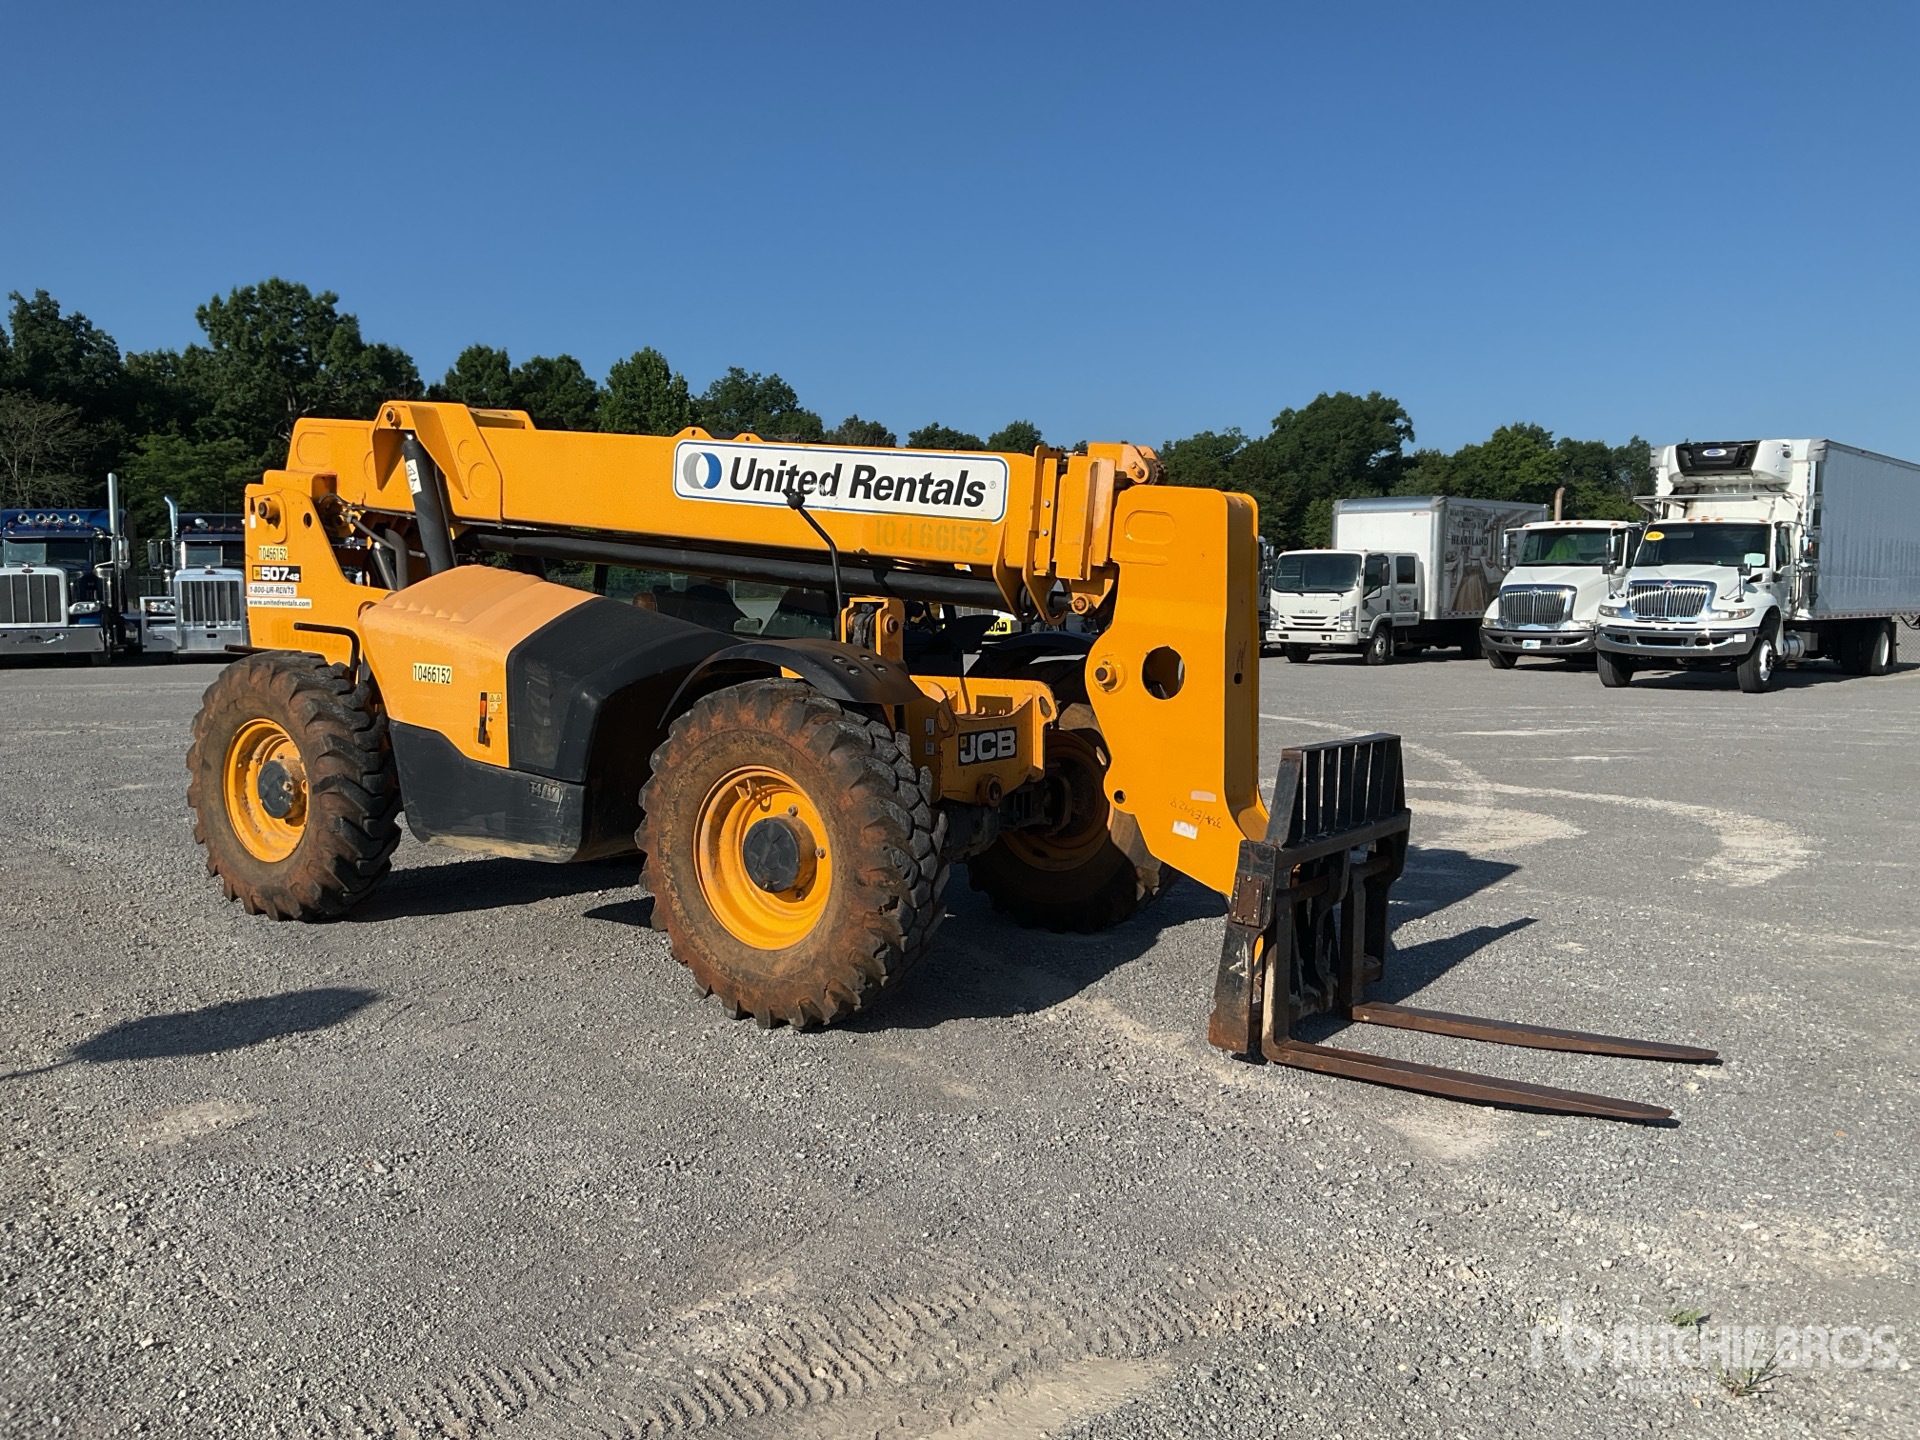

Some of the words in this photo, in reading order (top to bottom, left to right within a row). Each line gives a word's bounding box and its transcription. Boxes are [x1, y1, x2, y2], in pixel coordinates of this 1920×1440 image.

[730, 456, 843, 497] United
[848, 464, 987, 508] Rentals
[875, 519, 989, 556] 10466152
[258, 547, 287, 561] 10466152
[249, 586, 295, 595] 1-800-UR-RENTS
[249, 599, 311, 608] www.unitedrentals.com
[413, 665, 451, 684] 10466152
[959, 729, 1016, 763] JCB
